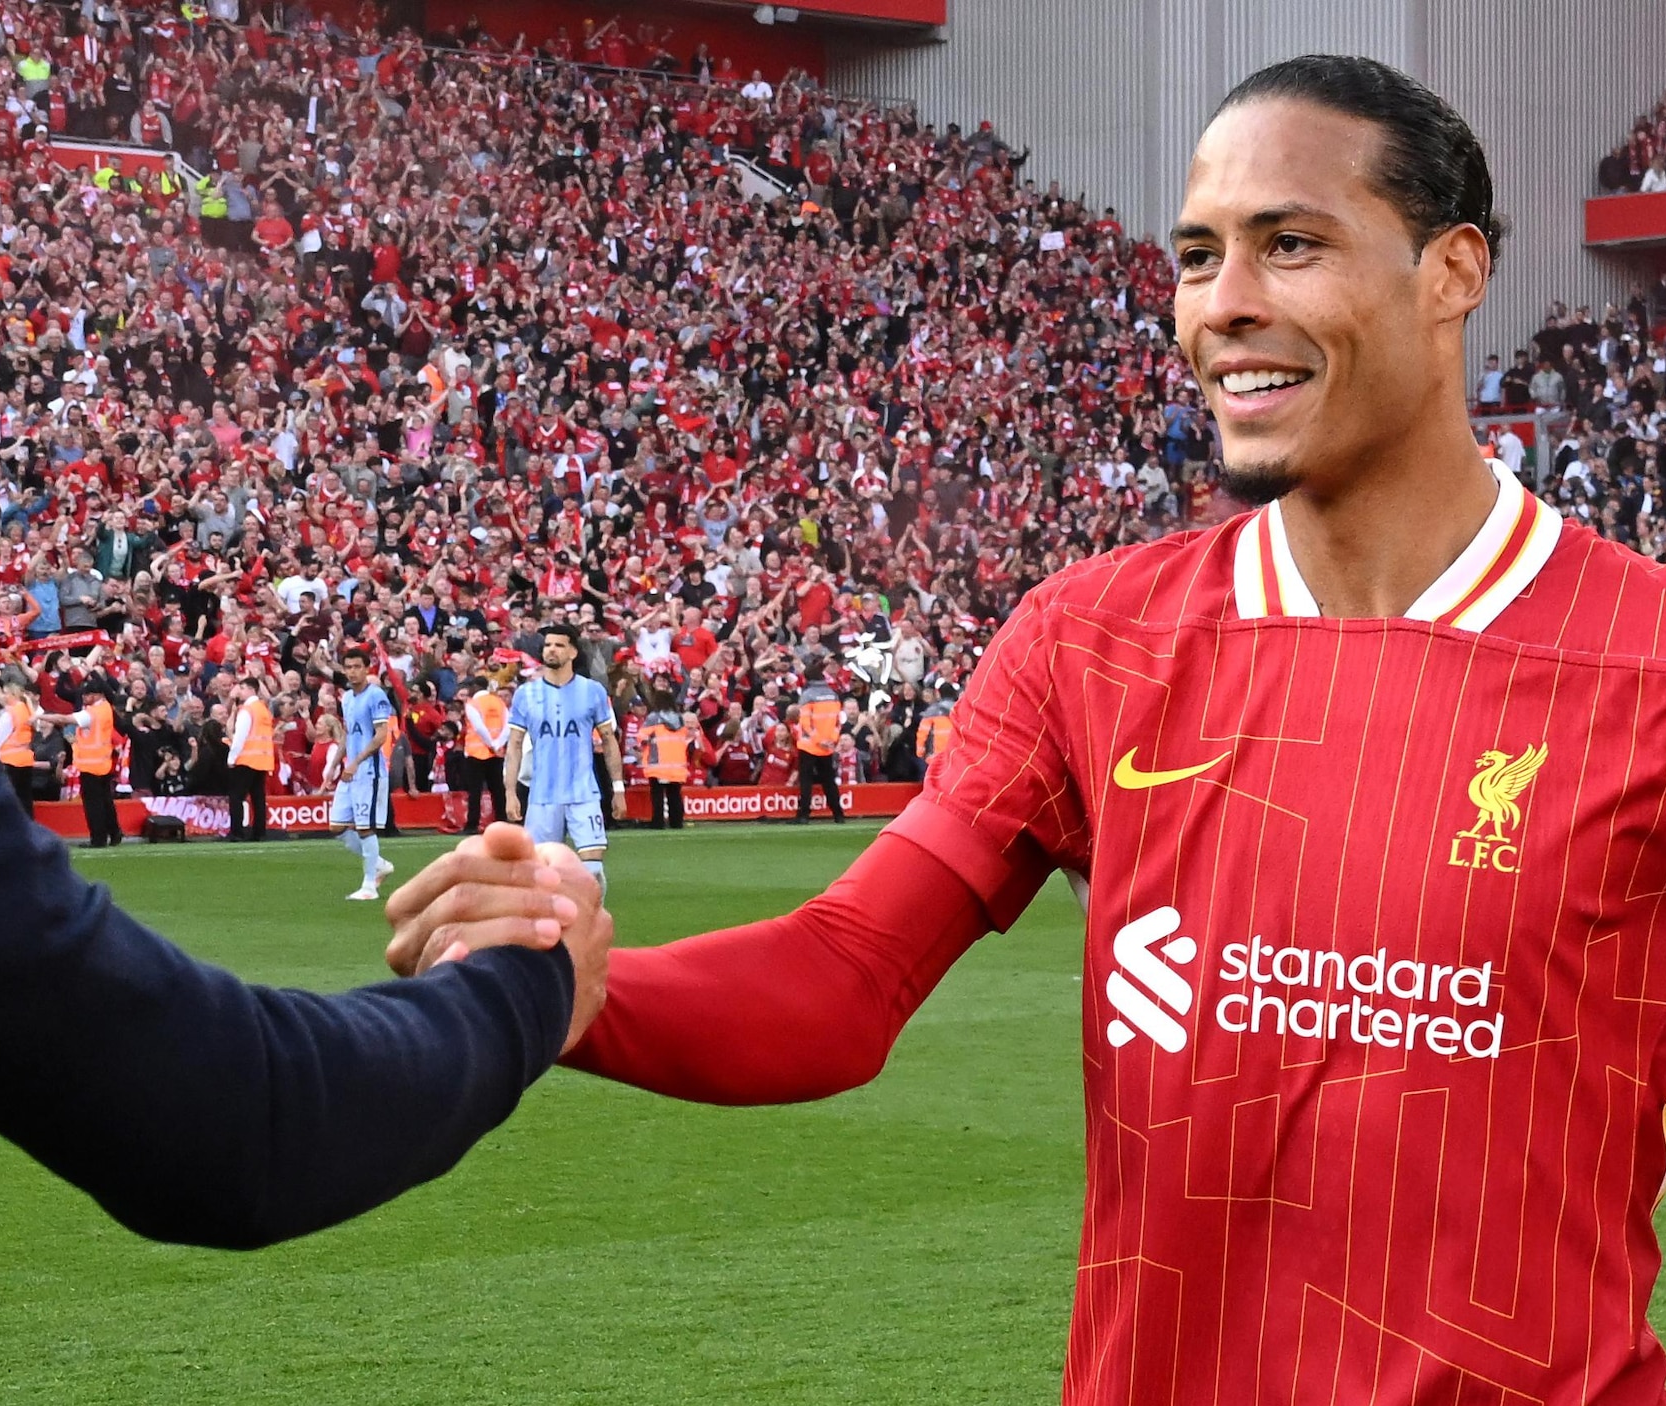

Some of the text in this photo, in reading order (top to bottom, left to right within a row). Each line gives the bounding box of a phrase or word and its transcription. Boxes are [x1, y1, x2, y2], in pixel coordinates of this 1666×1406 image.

[539, 720, 580, 739] AIA
[684, 792, 761, 815] tandard
[588, 815, 604, 832] 19
[1219, 934, 1493, 1007] standard
[1216, 985, 1504, 1059] chartered
